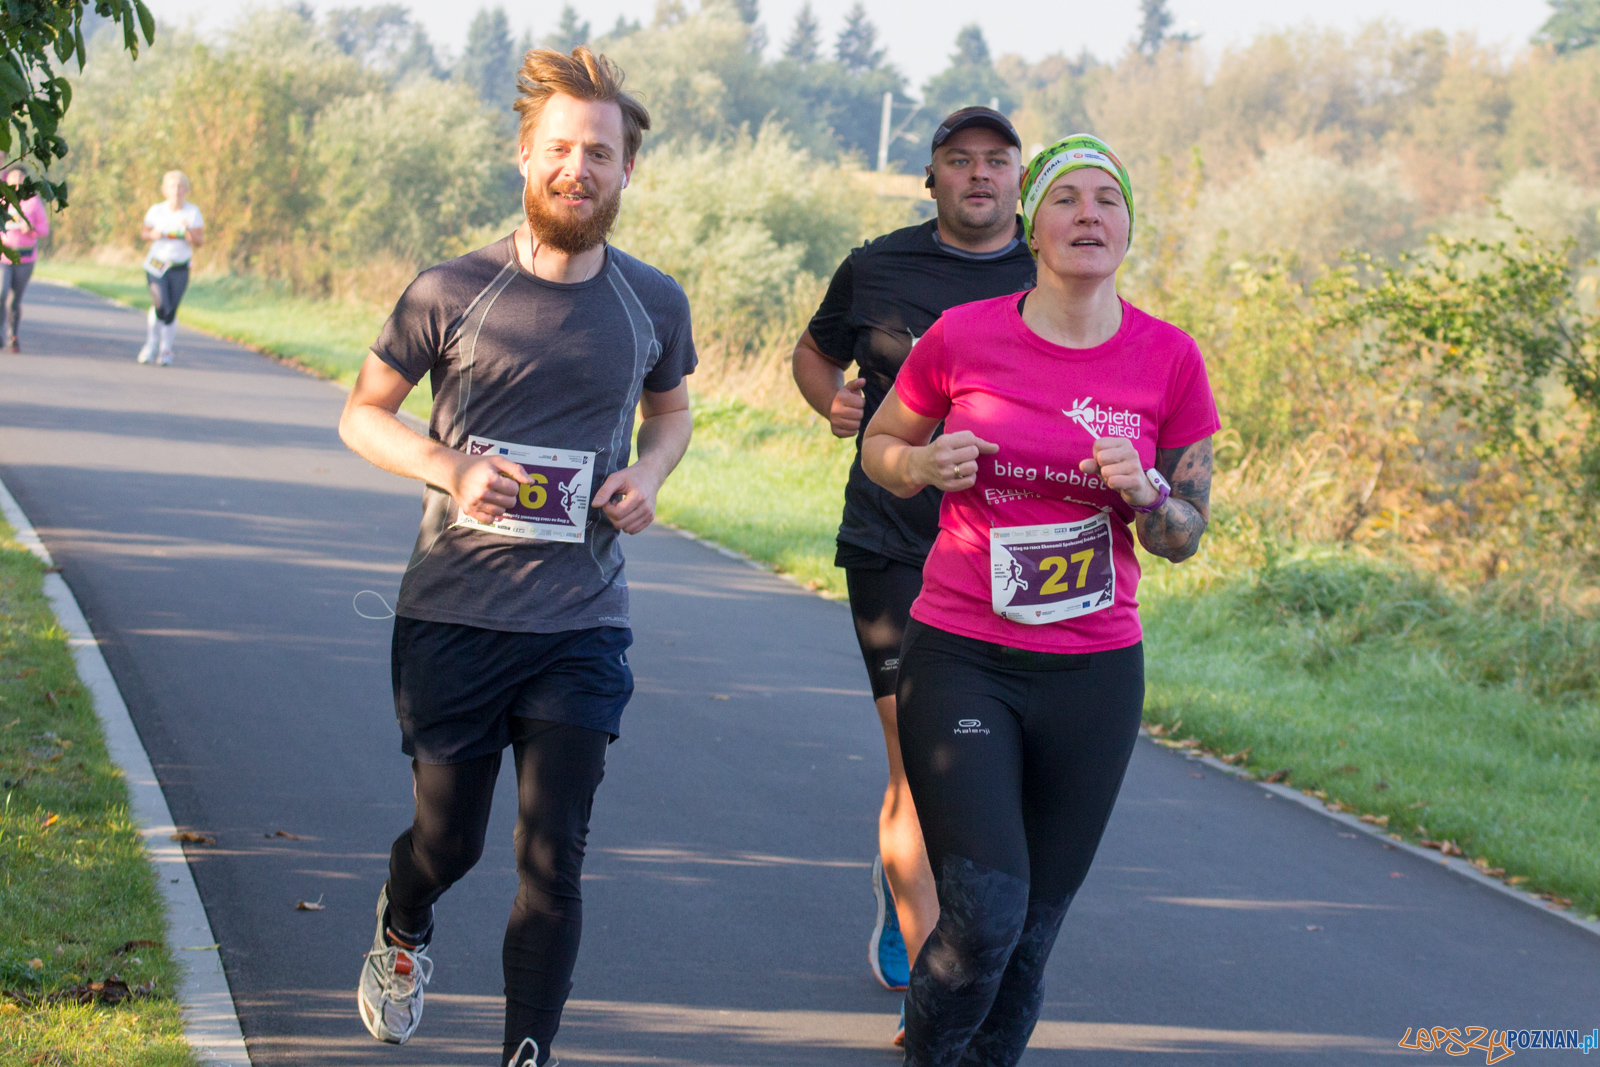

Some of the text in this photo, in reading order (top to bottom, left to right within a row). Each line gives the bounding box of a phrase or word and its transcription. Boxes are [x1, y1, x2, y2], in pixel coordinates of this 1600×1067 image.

[1108, 424, 1141, 440] BIEGU
[994, 459, 1038, 482] bieg
[1039, 548, 1095, 596] 27
[953, 727, 991, 736] Kalenji
